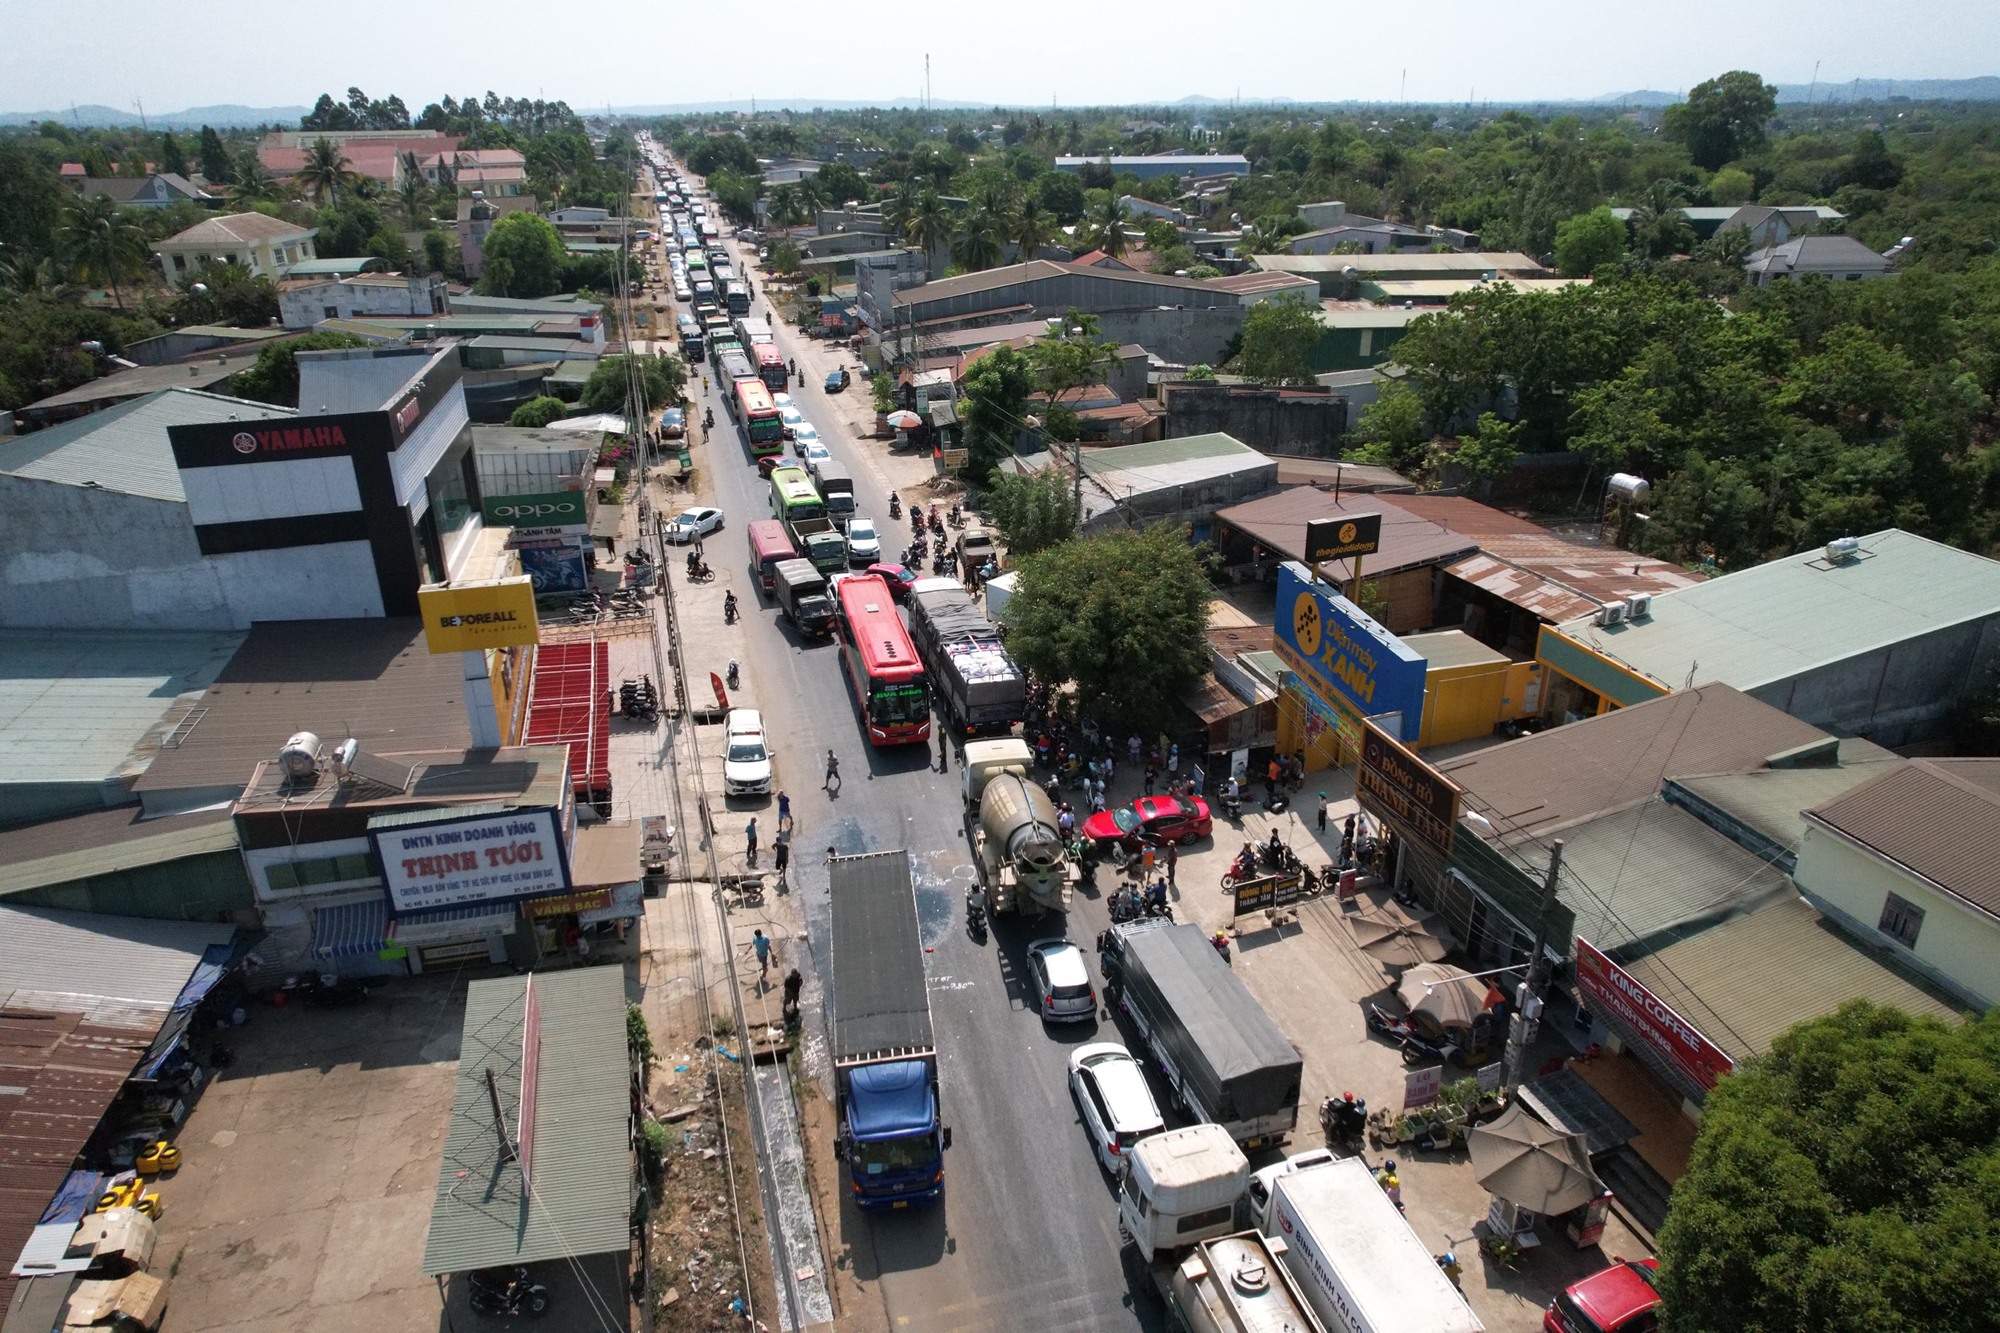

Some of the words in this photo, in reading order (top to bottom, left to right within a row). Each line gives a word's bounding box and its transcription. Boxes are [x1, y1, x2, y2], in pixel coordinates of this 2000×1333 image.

[256, 426, 346, 451] YAMAHA
[1315, 541, 1376, 558] thegioididong
[1321, 639, 1377, 704] XANH
[1351, 645, 1378, 675] máy
[401, 836, 434, 850] DNTN
[435, 831, 462, 845] KINH
[464, 827, 504, 842] DOANH
[505, 820, 537, 836] VÀNG
[401, 851, 479, 879] THỊNH
[484, 840, 544, 867] TƯƠI
[422, 885, 434, 894] MUA
[1609, 967, 1644, 1005] KING
[1644, 997, 1700, 1053] COFFEE
[1314, 1259, 1335, 1295] MINH
